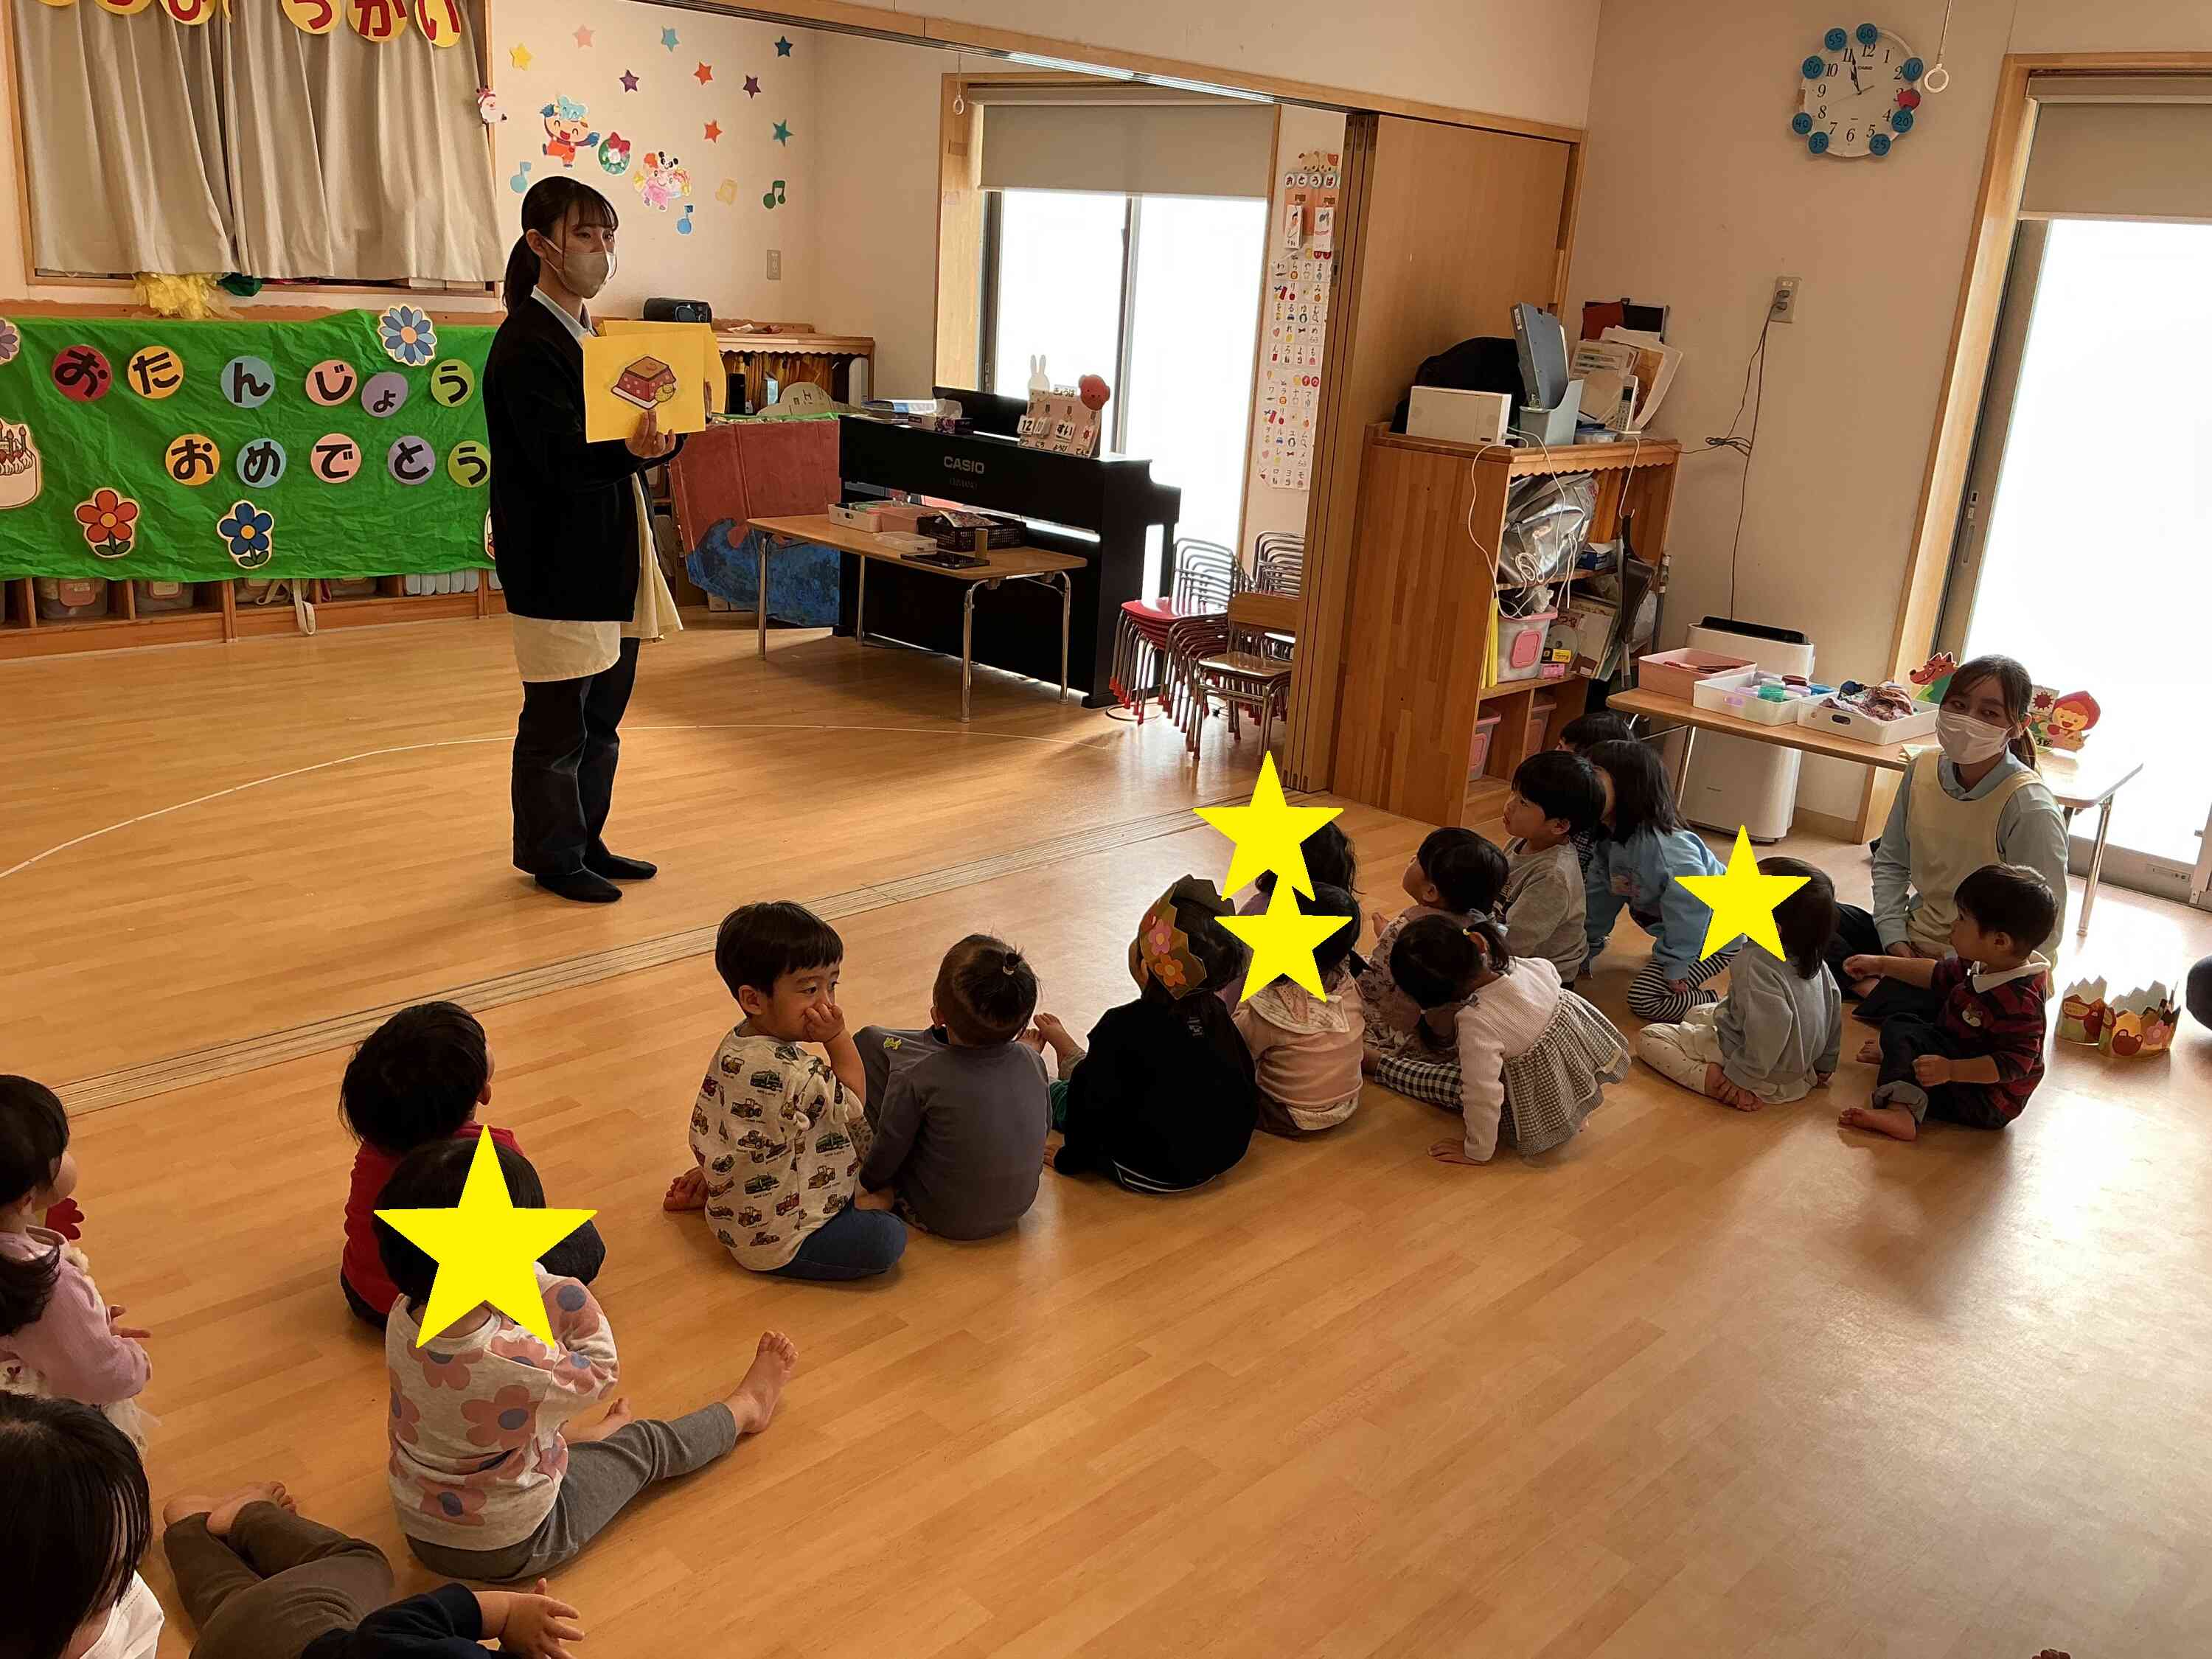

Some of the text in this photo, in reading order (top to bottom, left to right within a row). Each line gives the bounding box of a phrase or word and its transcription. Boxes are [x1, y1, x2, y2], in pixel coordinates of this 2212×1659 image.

[1828, 33, 1842, 45] 55
[1843, 48, 1853, 62] 11
[1862, 44, 1876, 57] 12
[1884, 49, 1890, 63] 1
[1808, 60, 1820, 74] 50
[1826, 63, 1838, 77] 10
[1893, 66, 1903, 80] 2
[1817, 84, 1826, 97] 9
[1818, 105, 1826, 119] 8
[1882, 108, 1891, 122] 4
[1795, 119, 1809, 128] 40
[1896, 116, 1909, 126] 20
[1829, 122, 1837, 135] 7
[1846, 128, 1855, 142] 6
[1866, 124, 1876, 138] 5
[1812, 138, 1824, 147] 35
[1874, 139, 1886, 149] 25
[54, 349, 468, 413] おたんじょう
[1023, 420, 1033, 431] 12
[170, 439, 488, 484] おめでとう
[944, 456, 984, 474] CASIO
